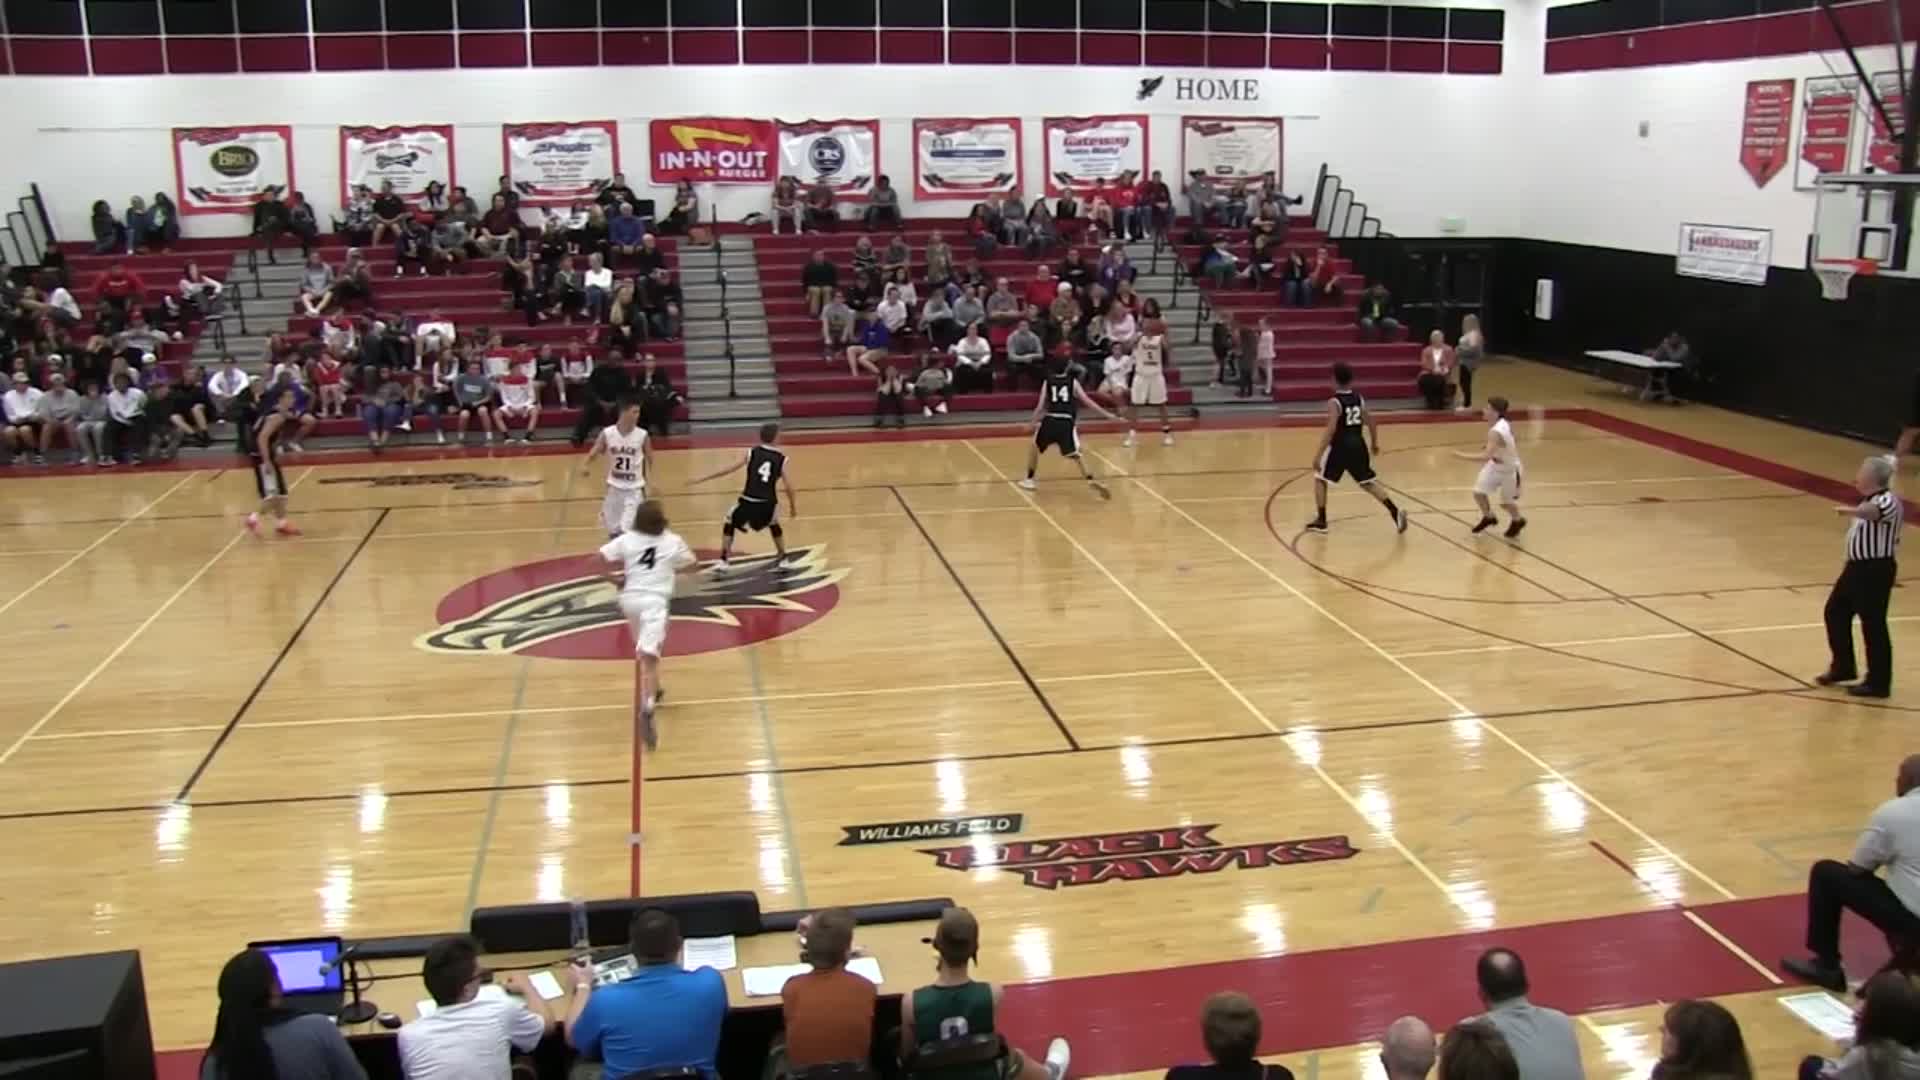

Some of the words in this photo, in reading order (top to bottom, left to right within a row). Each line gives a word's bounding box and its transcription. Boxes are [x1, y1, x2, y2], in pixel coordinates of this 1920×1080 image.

[1175, 78, 1259, 101] HOME
[659, 150, 768, 170] IN-N-OUT
[1051, 384, 1069, 402] 14
[615, 457, 630, 470] 21
[757, 461, 772, 483] 4
[638, 546, 657, 569] 4
[858, 822, 950, 841] WILLIAMS
[955, 817, 1011, 834] FLD
[1024, 835, 1357, 890] HAWKS
